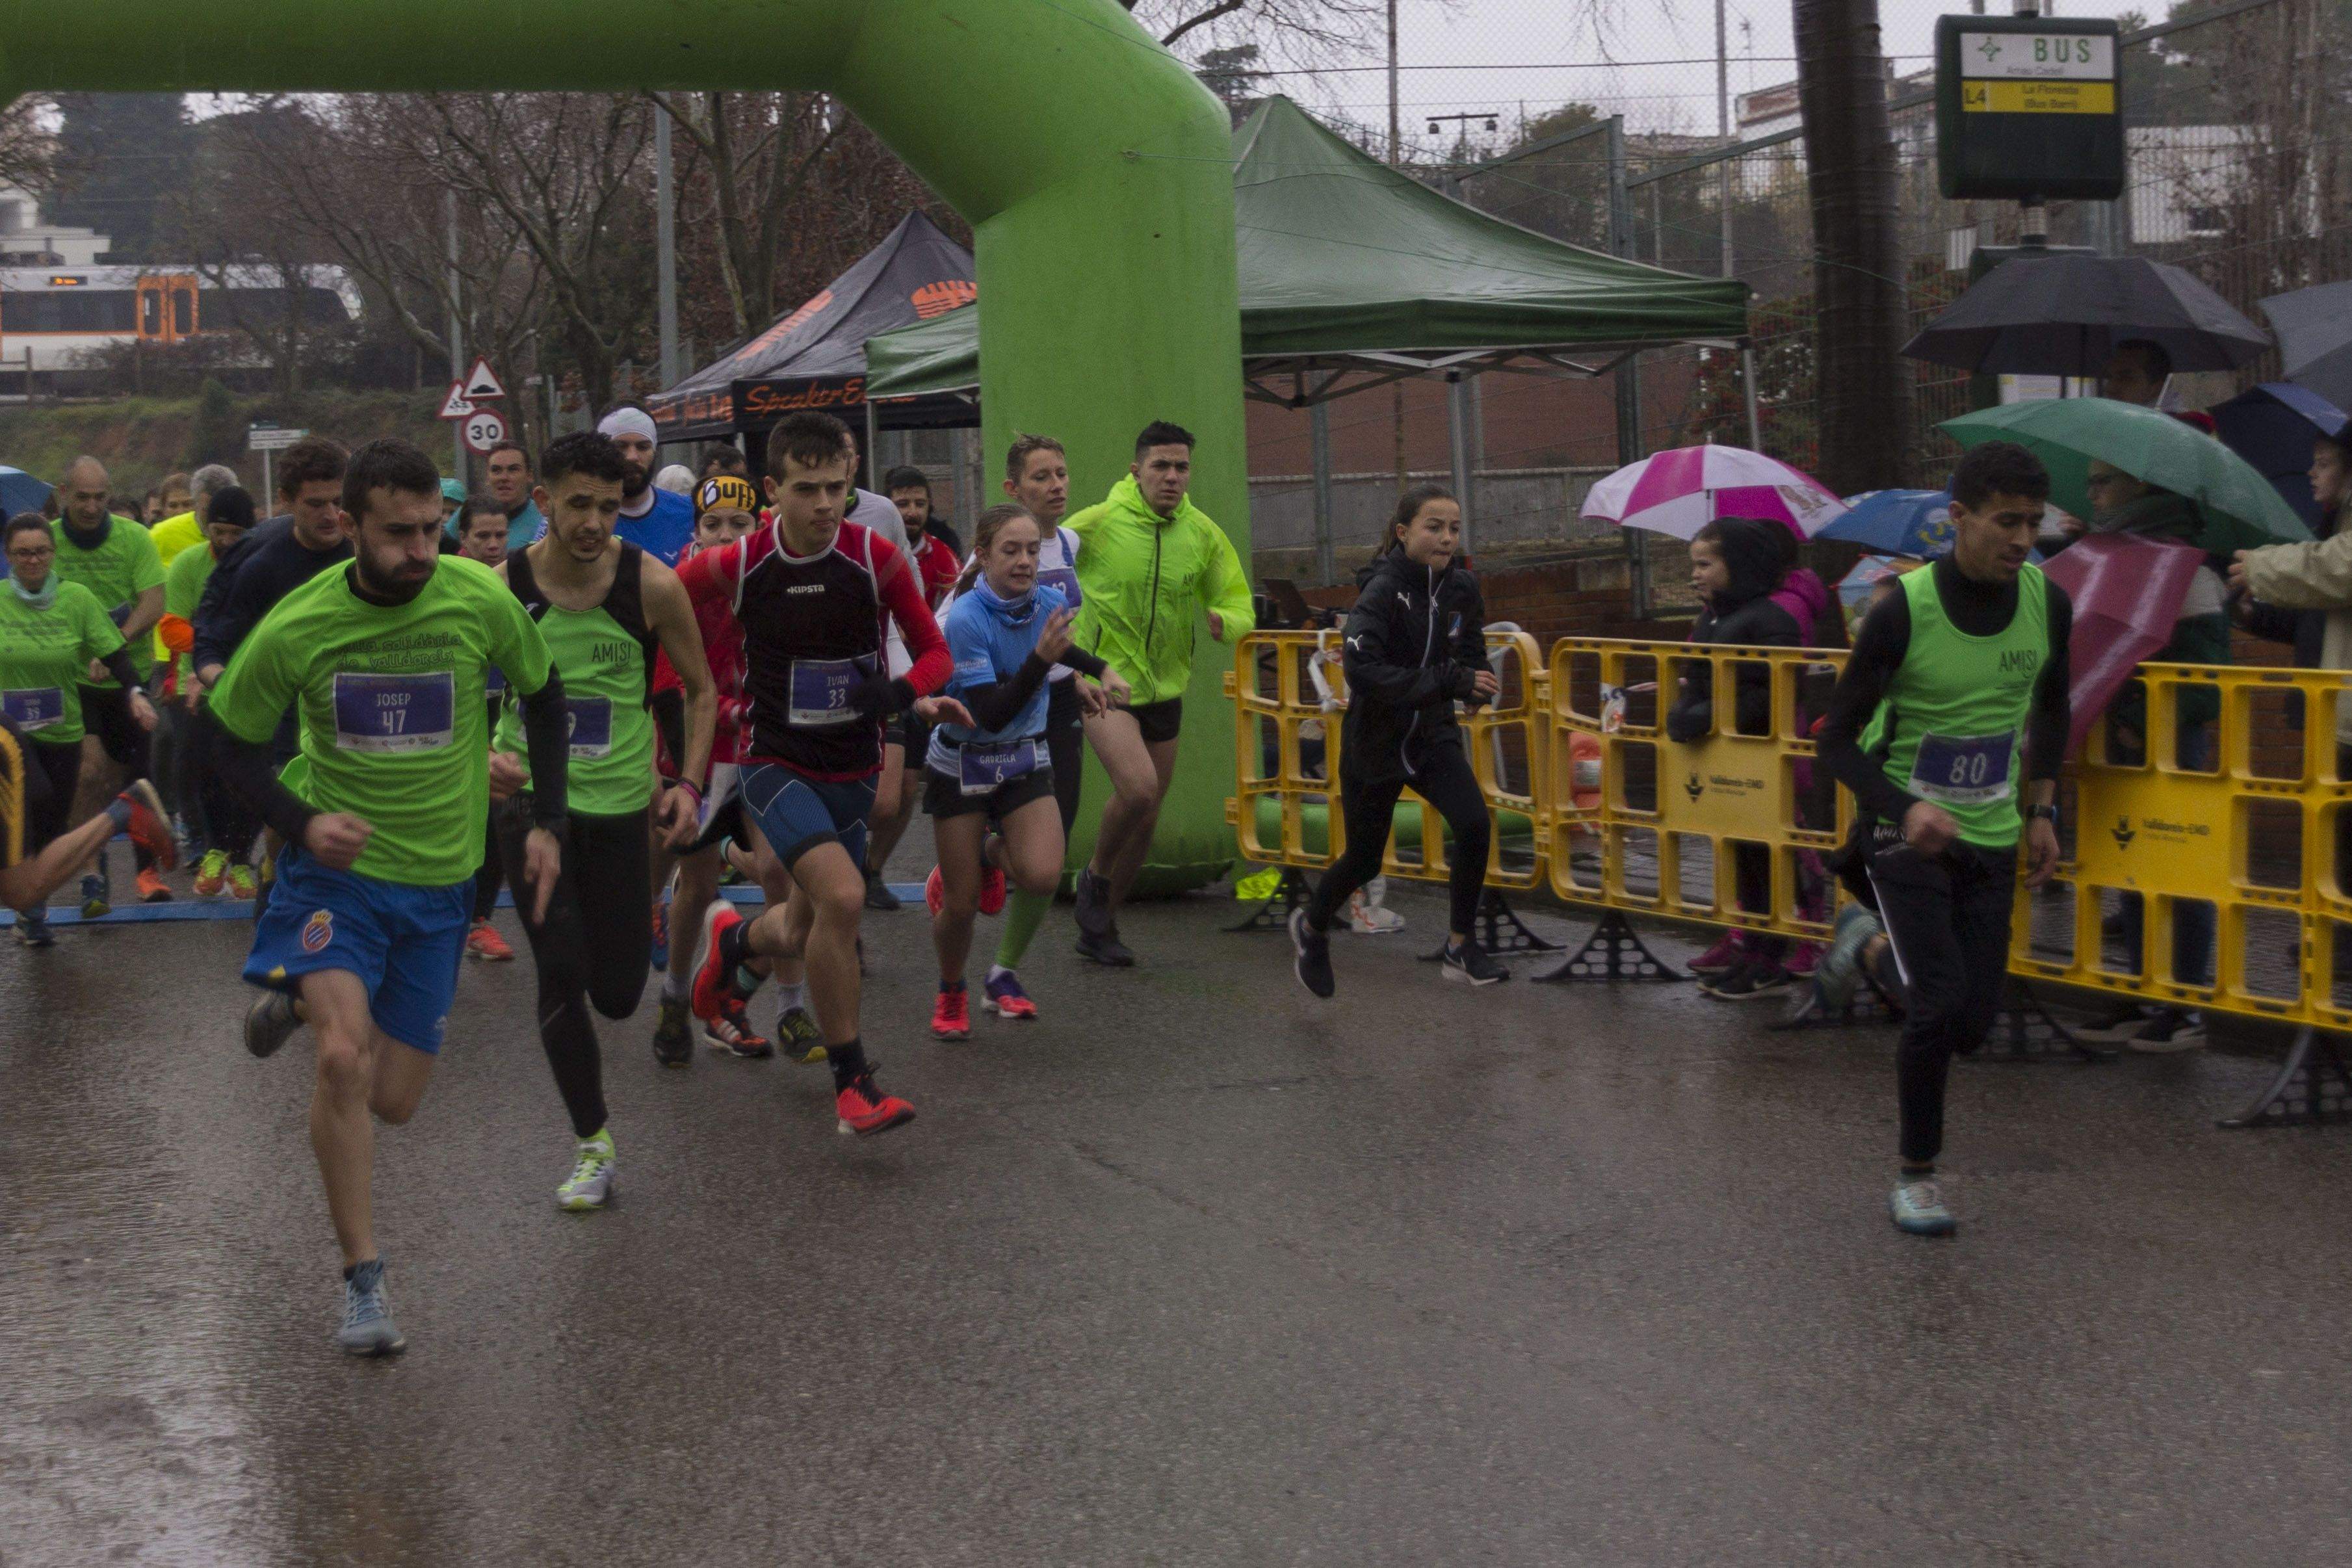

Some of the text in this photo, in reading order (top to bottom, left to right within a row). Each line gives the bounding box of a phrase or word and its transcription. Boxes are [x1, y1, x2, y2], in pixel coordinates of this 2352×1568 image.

[2033, 38, 2091, 63] BUS
[1965, 88, 1986, 105] L4
[471, 424, 499, 441] 30
[827, 674, 850, 688] IVAN
[376, 693, 411, 707] JOSEP
[828, 688, 846, 709] 33
[382, 709, 406, 734] 47
[995, 766, 1004, 783] 6
[1950, 752, 1987, 784] 80
